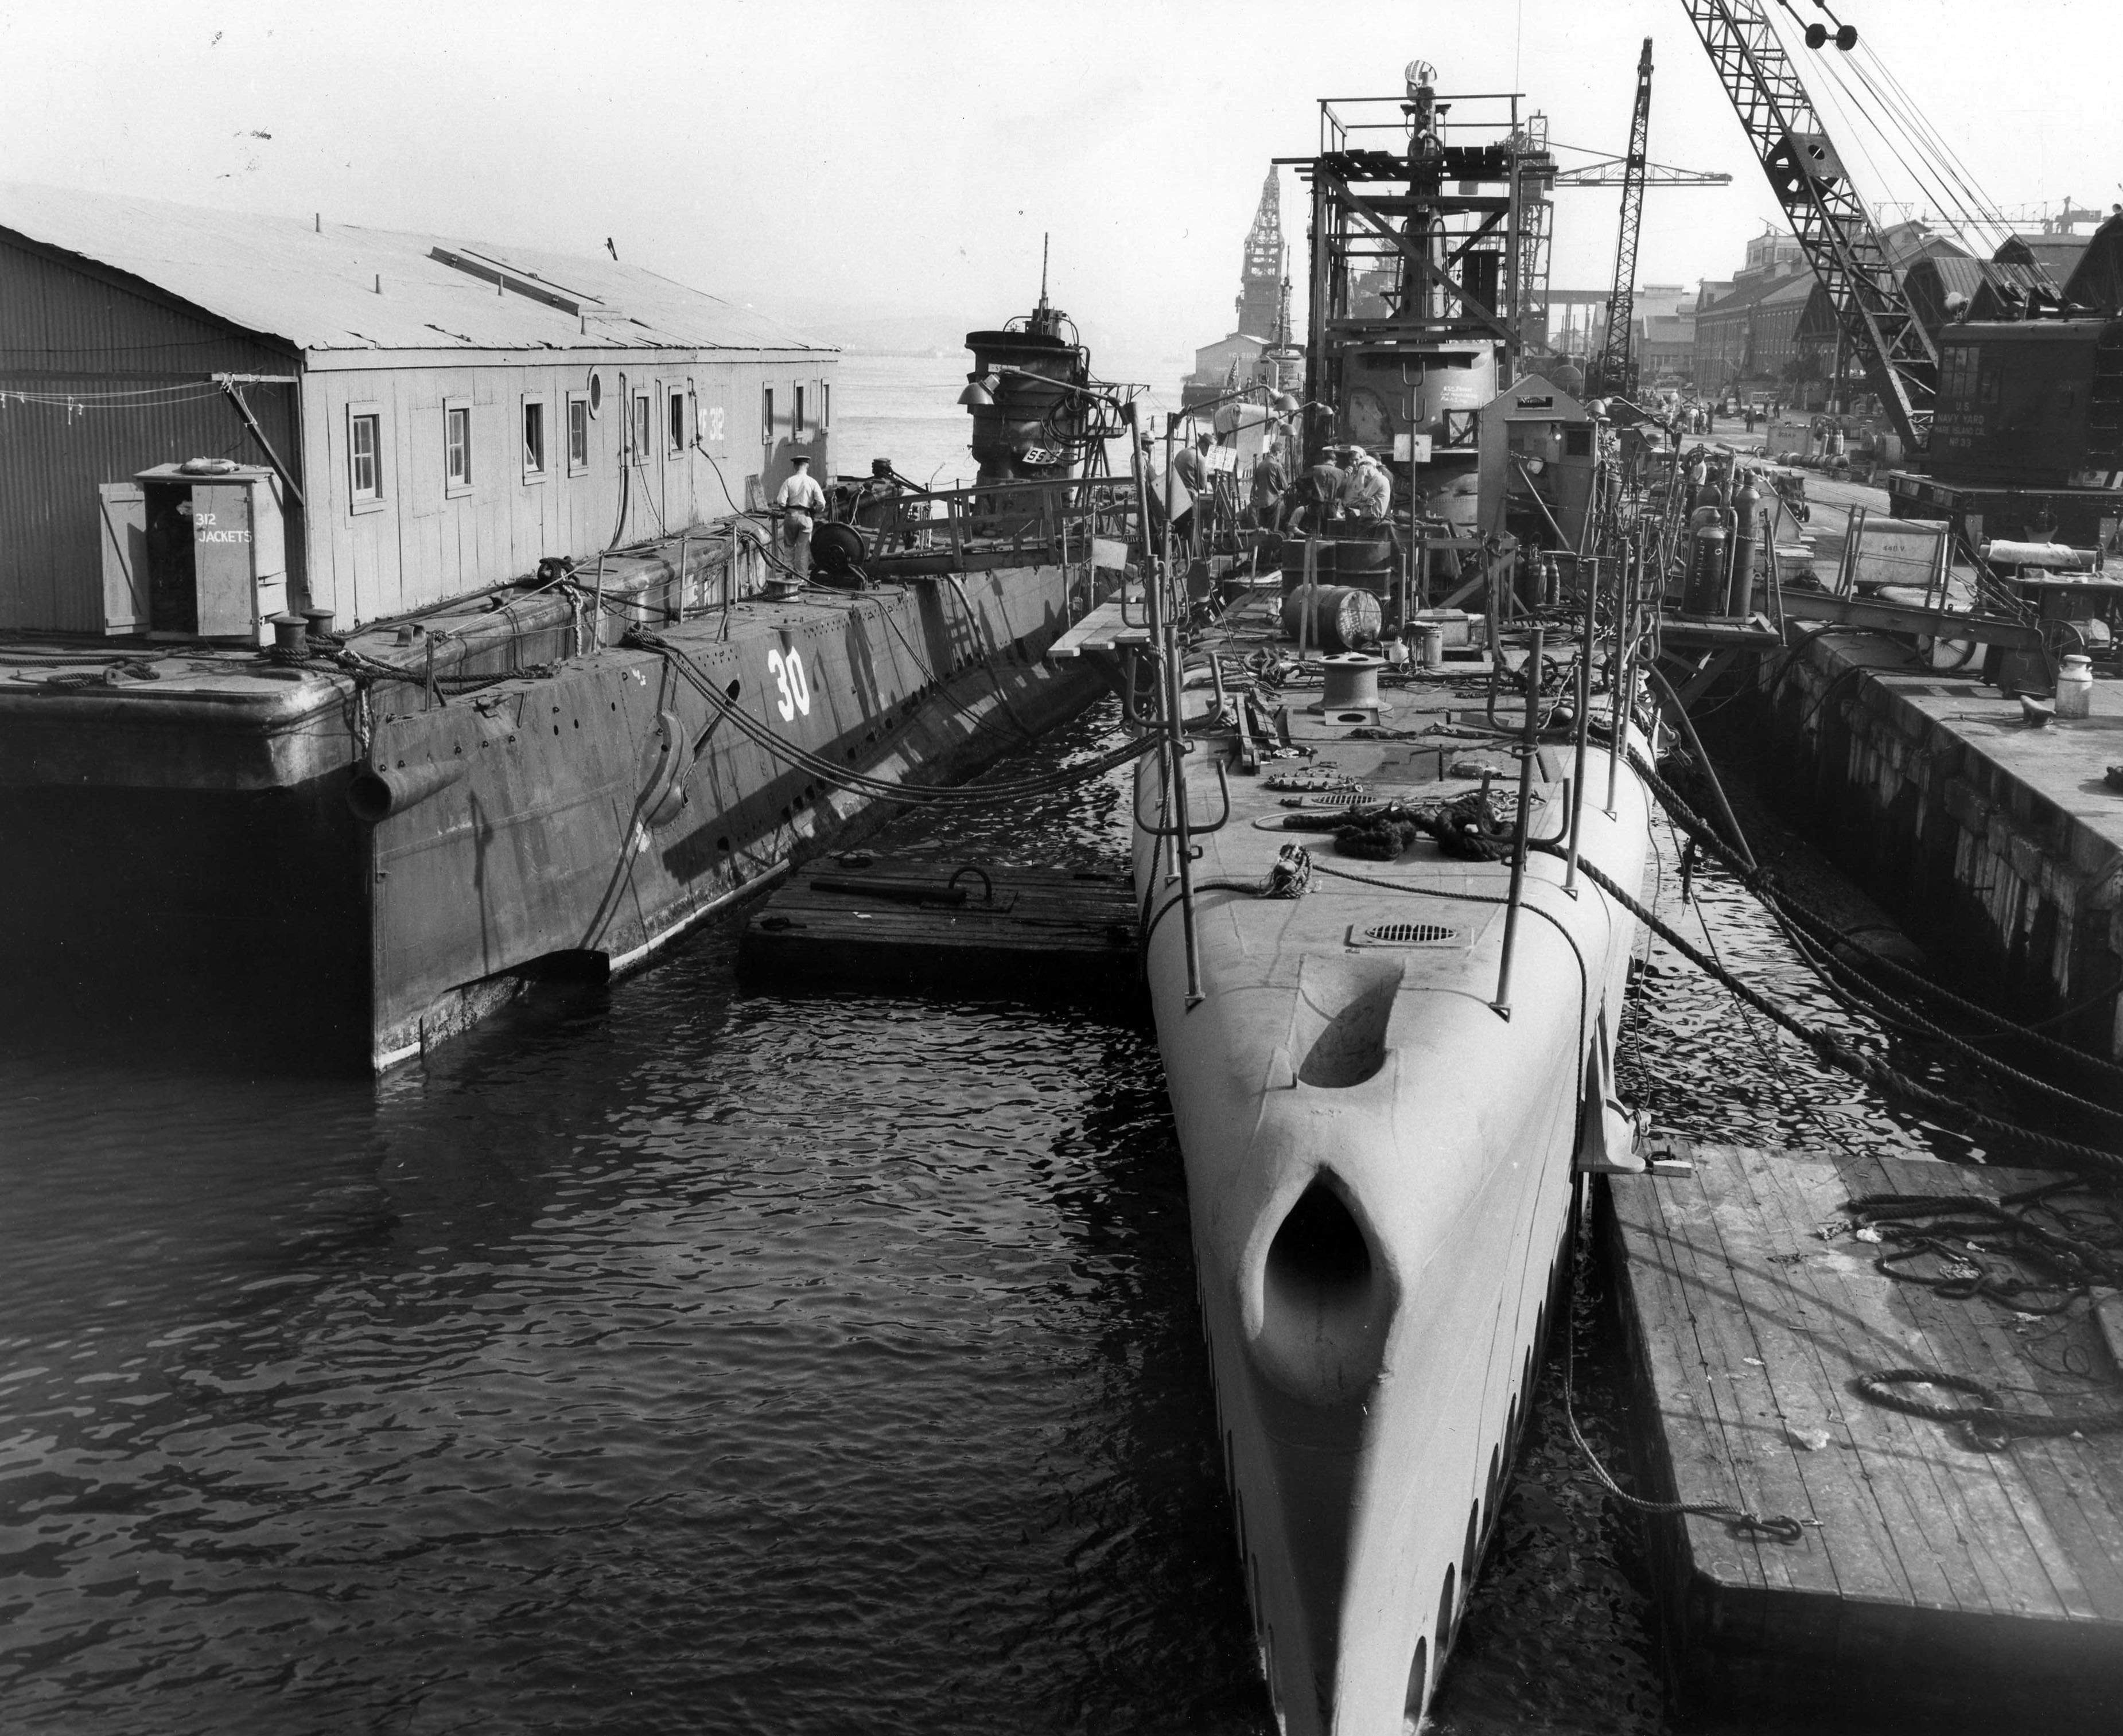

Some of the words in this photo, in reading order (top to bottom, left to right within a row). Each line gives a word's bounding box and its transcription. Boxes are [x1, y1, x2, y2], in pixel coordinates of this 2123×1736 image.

[710, 407, 724, 441] 312
[1938, 413, 1959, 423] NAVY
[1962, 414, 1985, 425] YARD
[1026, 449, 1047, 462] SS
[195, 512, 216, 526] 312
[199, 530, 252, 543] JACKETS
[767, 645, 811, 722] 30
